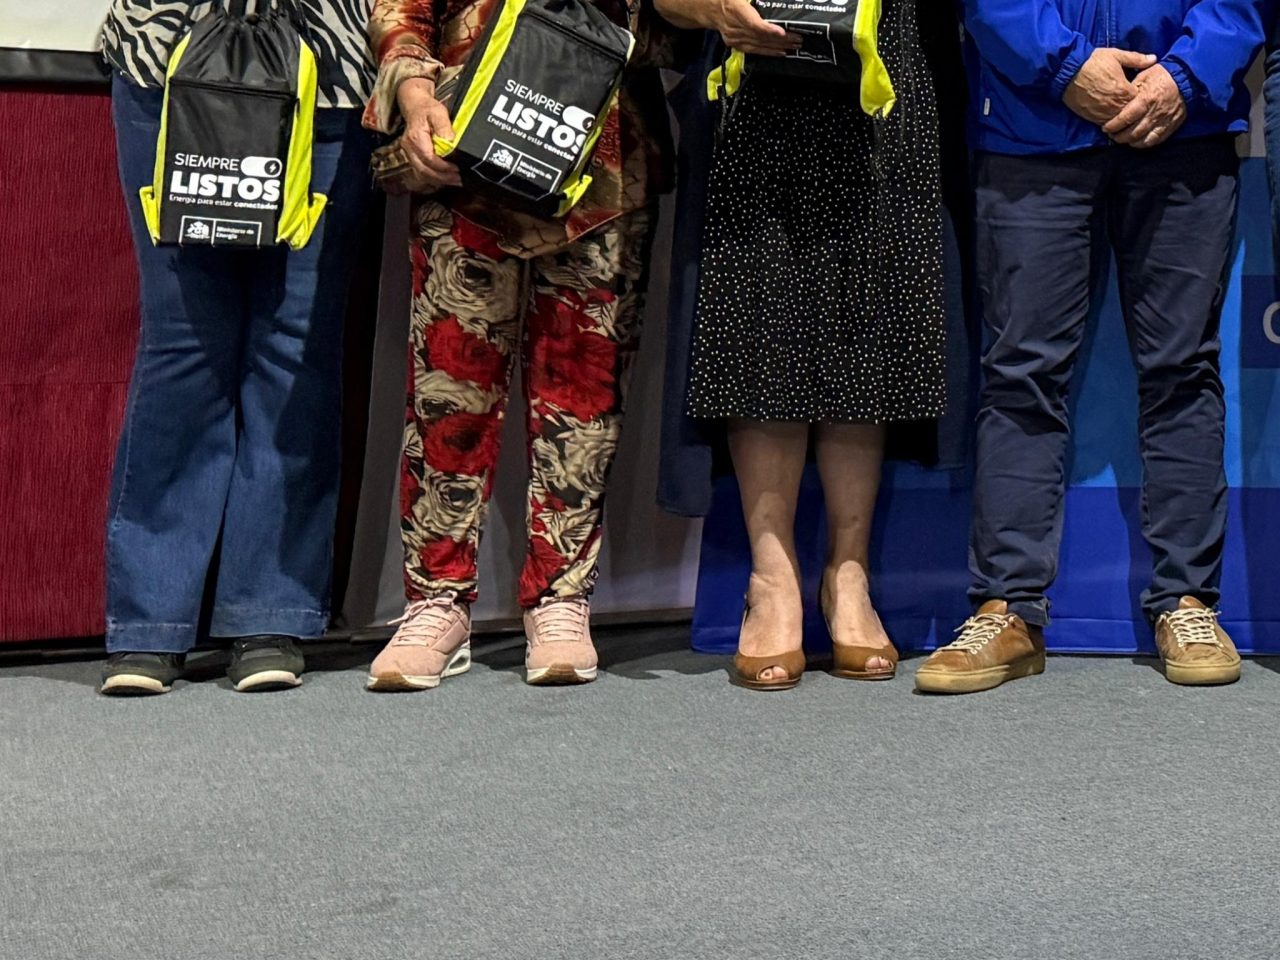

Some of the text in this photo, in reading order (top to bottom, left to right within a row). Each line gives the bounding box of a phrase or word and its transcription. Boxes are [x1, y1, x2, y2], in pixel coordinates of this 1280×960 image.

[504, 79, 565, 116] SIEMPRE
[174, 152, 240, 171] SIEMPRE
[170, 170, 281, 202] LISTOS
[197, 198, 214, 206] para
[233, 201, 278, 210] conectados
